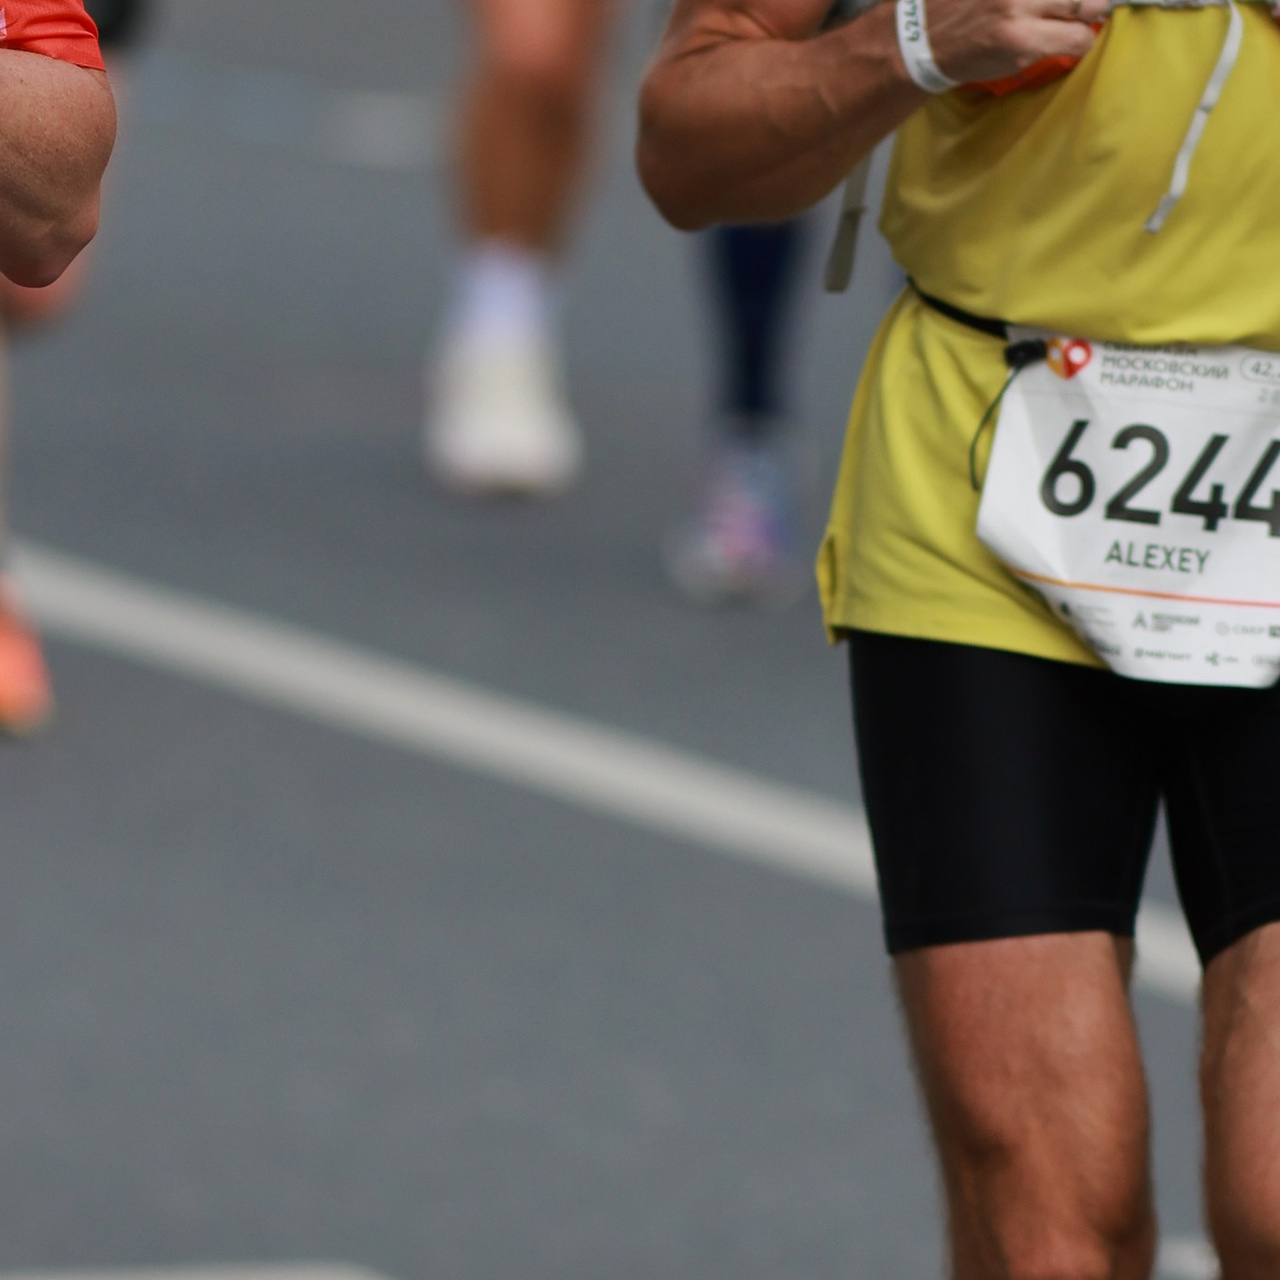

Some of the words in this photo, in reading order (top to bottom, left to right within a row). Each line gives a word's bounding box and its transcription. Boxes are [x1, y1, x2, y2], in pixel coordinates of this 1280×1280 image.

[1100, 372, 1194, 392] МАРАФОН
[1101, 355, 1229, 380] МОСКОВСКИЙ
[1039, 419, 1280, 538] 6244
[1104, 539, 1211, 575] ALEXEY
